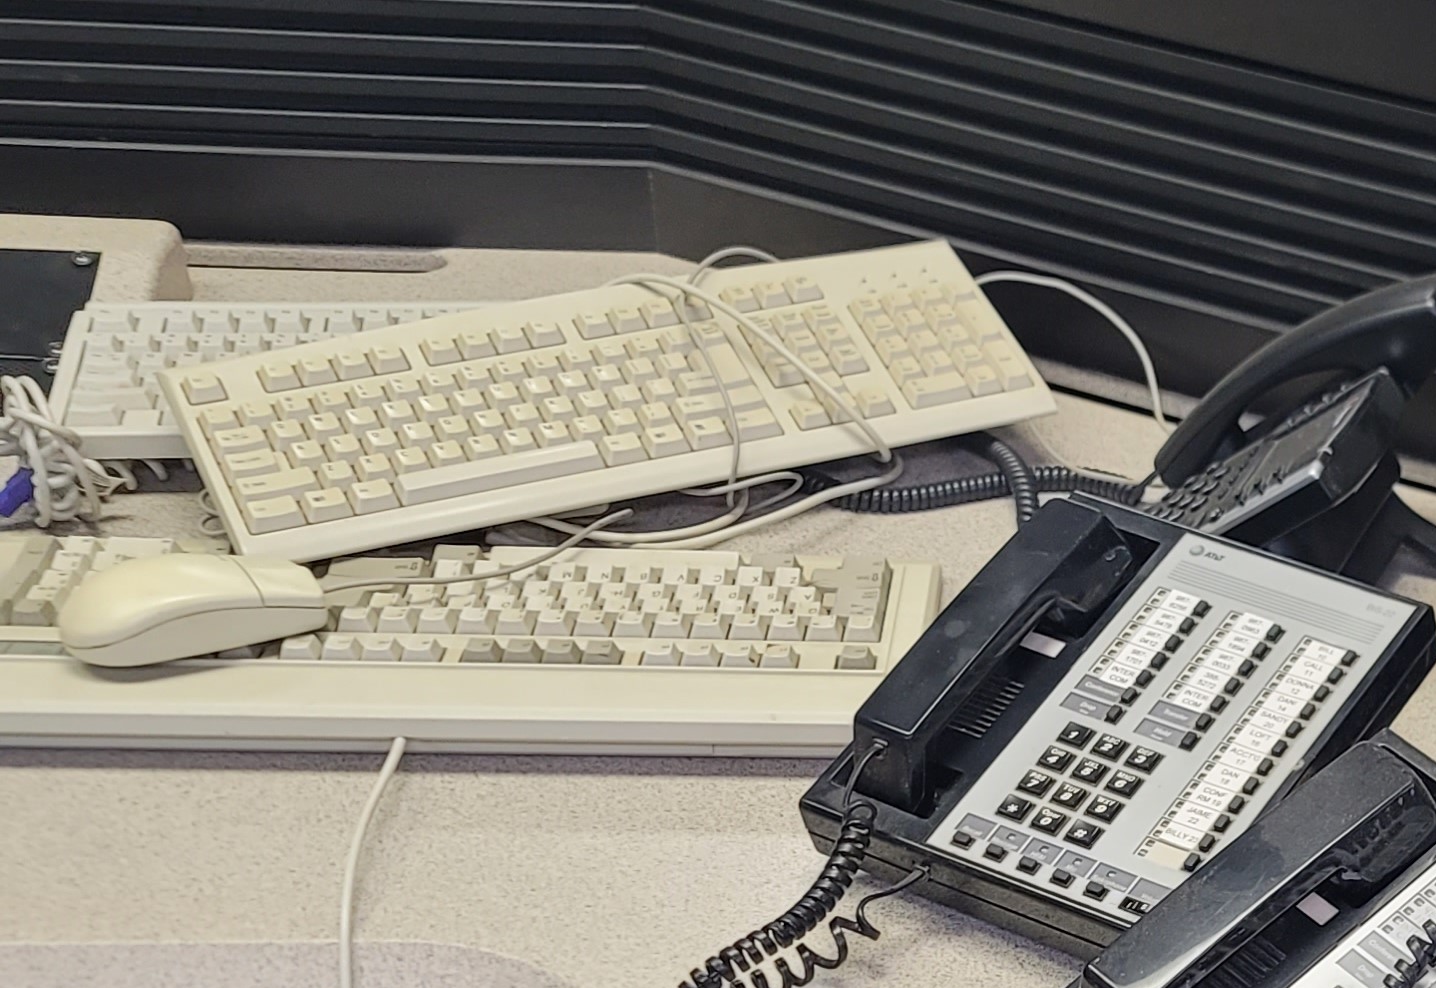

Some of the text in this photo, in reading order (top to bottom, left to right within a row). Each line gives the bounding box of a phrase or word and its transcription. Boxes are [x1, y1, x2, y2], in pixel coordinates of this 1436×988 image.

[1112, 666, 1135, 677] INTER
[1109, 675, 1128, 683] COM
[1184, 689, 1209, 701] INTER
[1182, 699, 1202, 707] COM
[1261, 711, 1288, 723] SANDY
[1250, 730, 1272, 740] LOFT
[1103, 736, 1120, 745] ABC
[1221, 769, 1240, 778] DAN
[1203, 787, 1227, 797] CONF
[1197, 794, 1211, 802] RM
[1187, 807, 1213, 818] JAIME
[1166, 828, 1187, 839] BILLY
